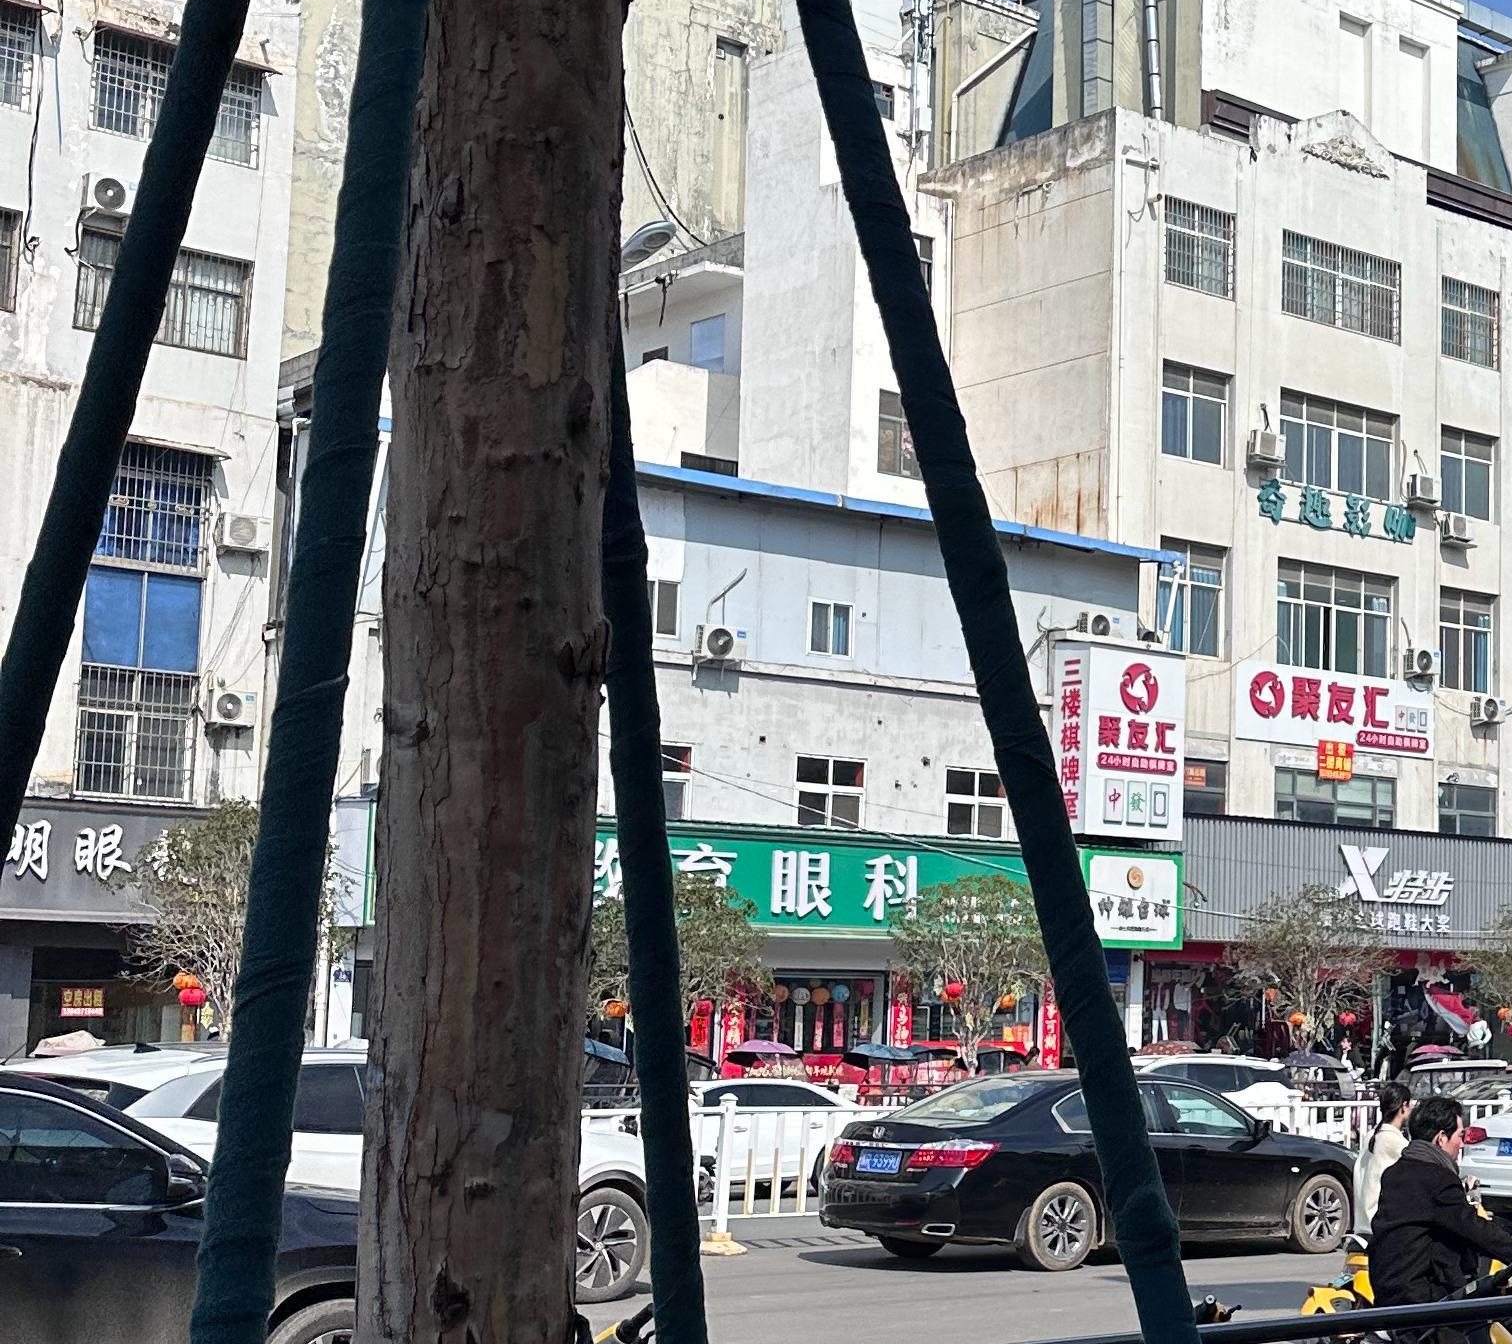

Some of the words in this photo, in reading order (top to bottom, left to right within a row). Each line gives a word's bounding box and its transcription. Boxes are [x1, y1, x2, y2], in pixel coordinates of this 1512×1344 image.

[1291, 675, 1390, 729] 聚友汇
[1060, 658, 1082, 820] 三楼棋牌室
[1098, 715, 1177, 754] 聚友汇
[6, 818, 165, 882] 明眼
[594, 841, 920, 923] 育眼科
[1383, 869, 1455, 906] 特步
[63, 989, 103, 1007] 空房出租
